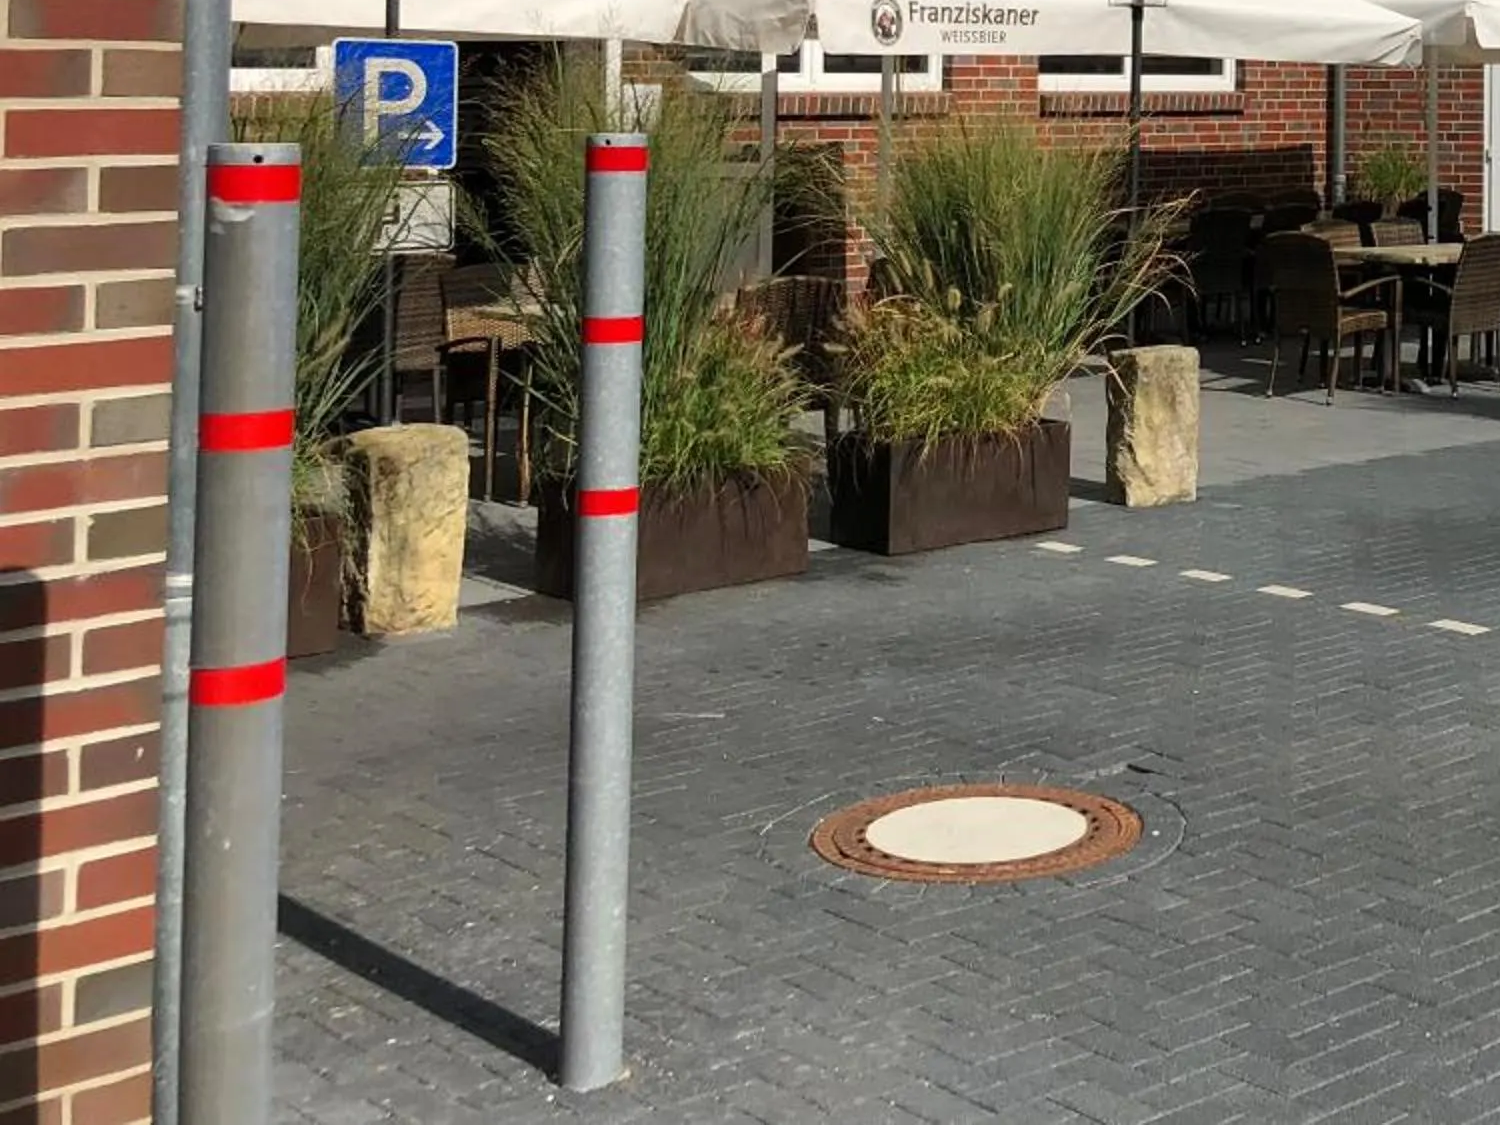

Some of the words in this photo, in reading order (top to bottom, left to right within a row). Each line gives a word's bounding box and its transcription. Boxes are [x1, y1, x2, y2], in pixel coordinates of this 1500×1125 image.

[908, 1, 1040, 26] Franziskaner
[940, 30, 1007, 44] WEISSBIER
[364, 57, 427, 149] P
